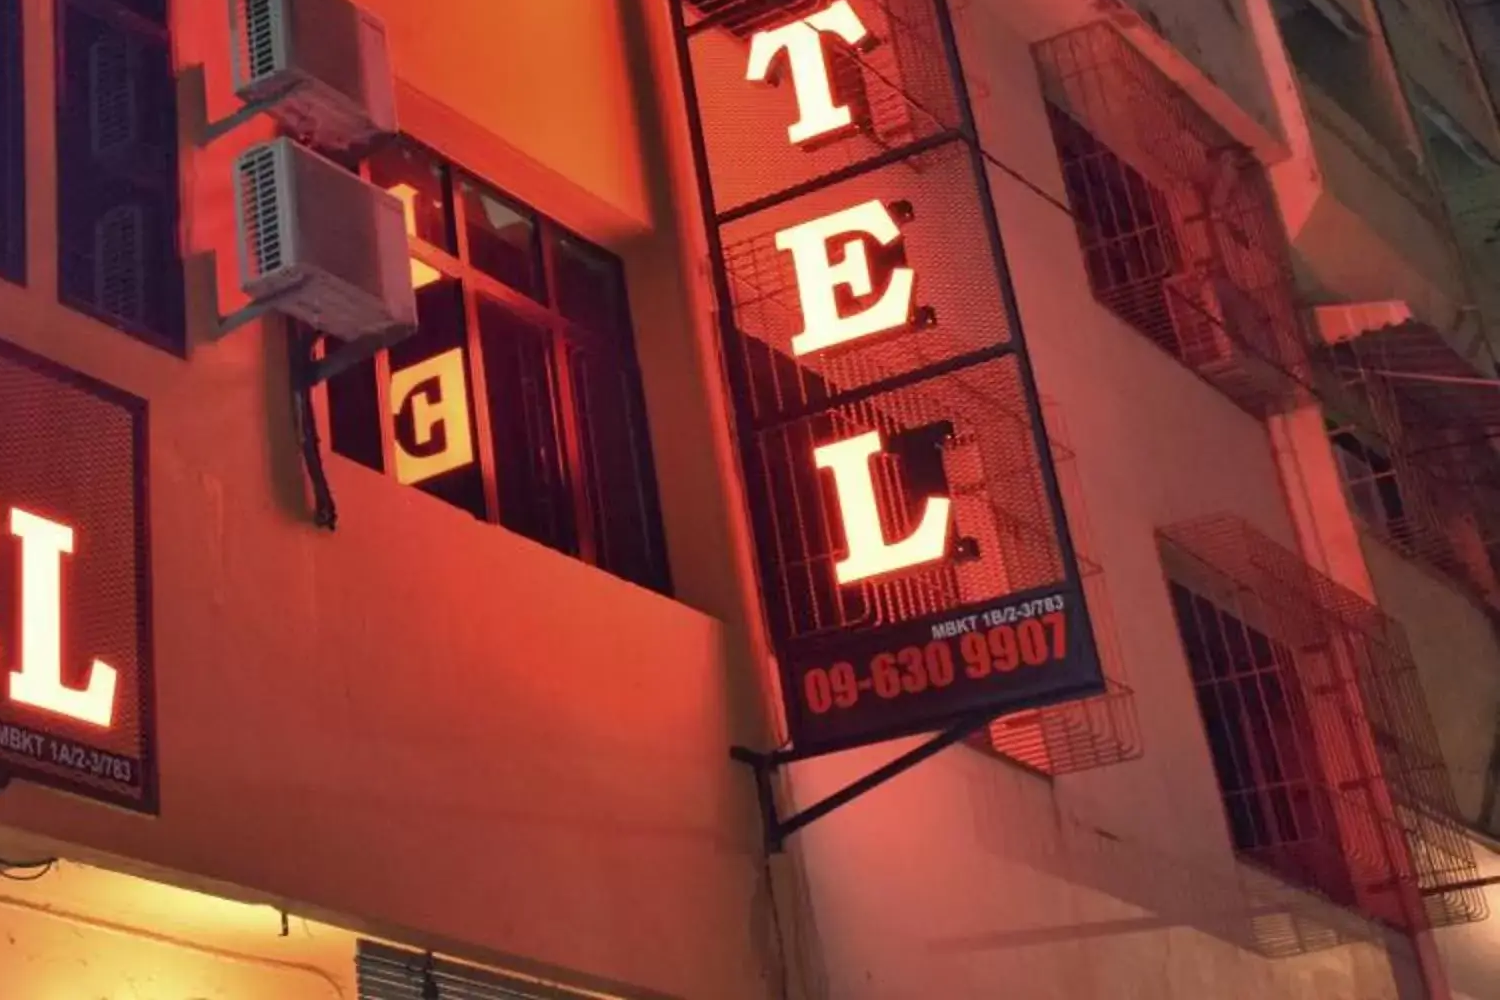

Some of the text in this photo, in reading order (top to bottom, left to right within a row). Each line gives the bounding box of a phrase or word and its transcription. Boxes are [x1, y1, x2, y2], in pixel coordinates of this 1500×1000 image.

[930, 614, 978, 641] MBKT
[803, 610, 1067, 715] 09-630 9907
